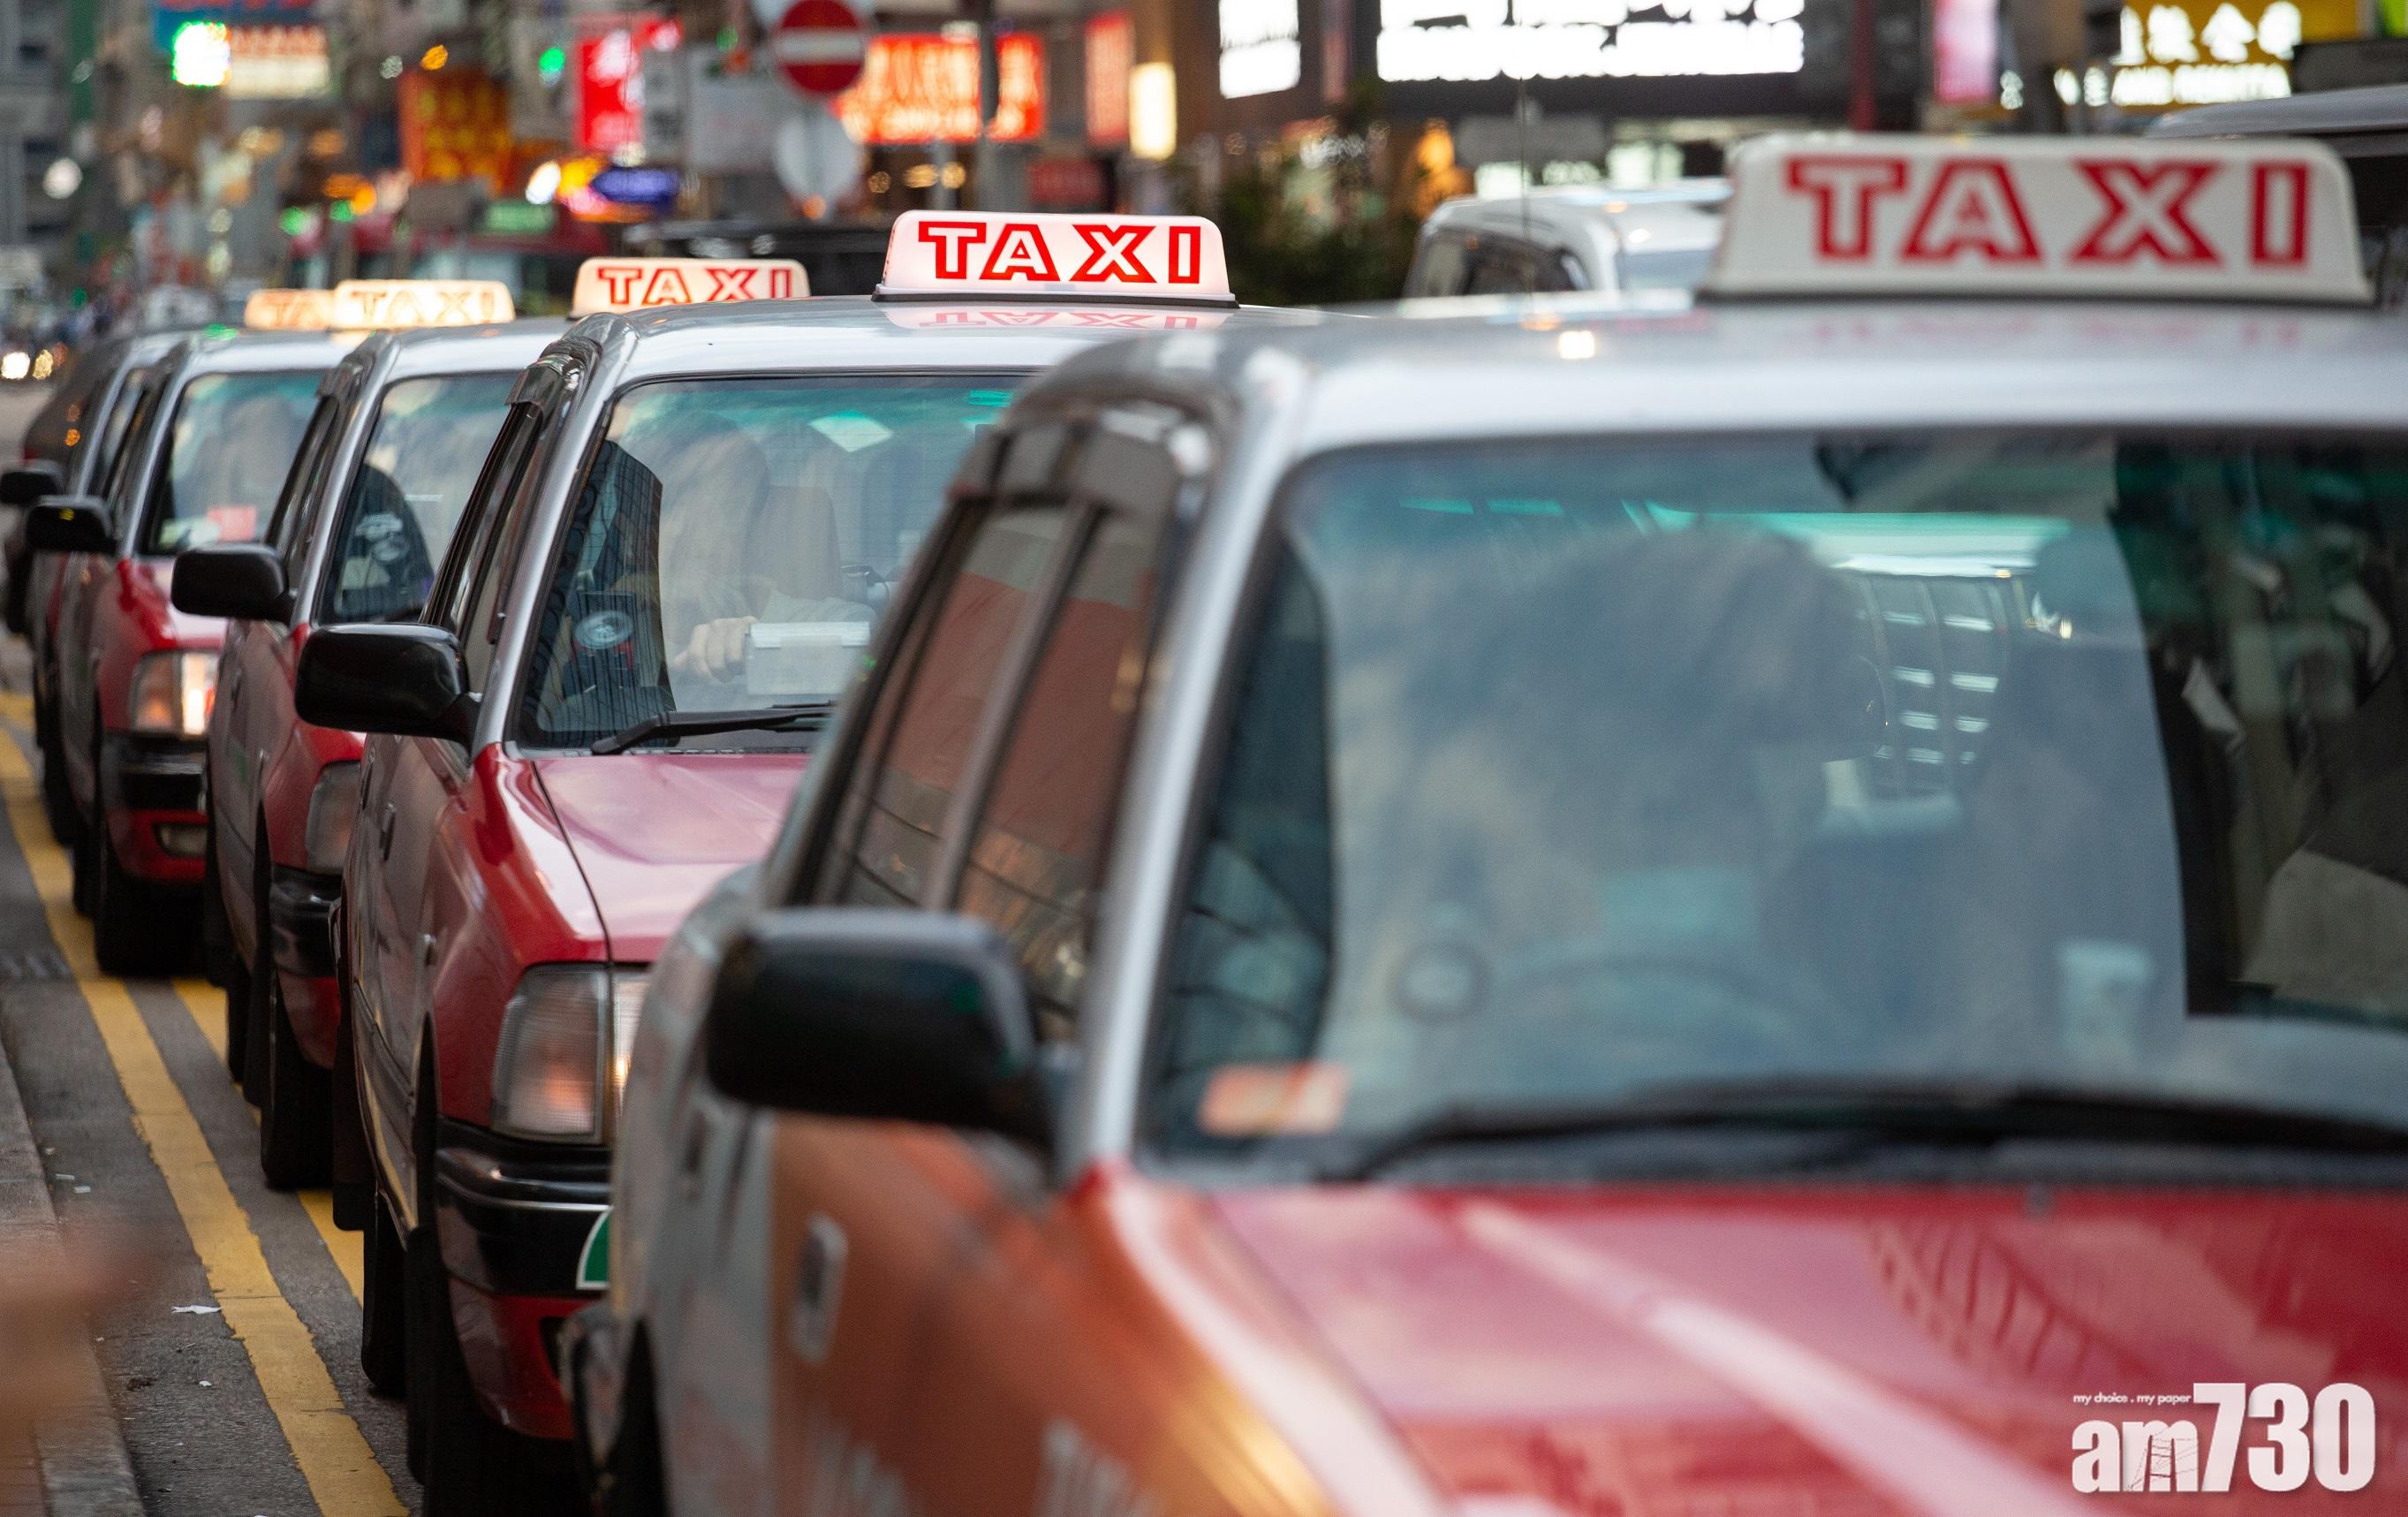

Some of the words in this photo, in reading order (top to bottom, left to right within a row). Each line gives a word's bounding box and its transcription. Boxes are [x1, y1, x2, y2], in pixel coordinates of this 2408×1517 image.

[1785, 156, 2310, 269] TAXI
[919, 221, 1201, 284] TAXI
[350, 290, 495, 327] TAXI
[597, 268, 791, 306] TAXI
